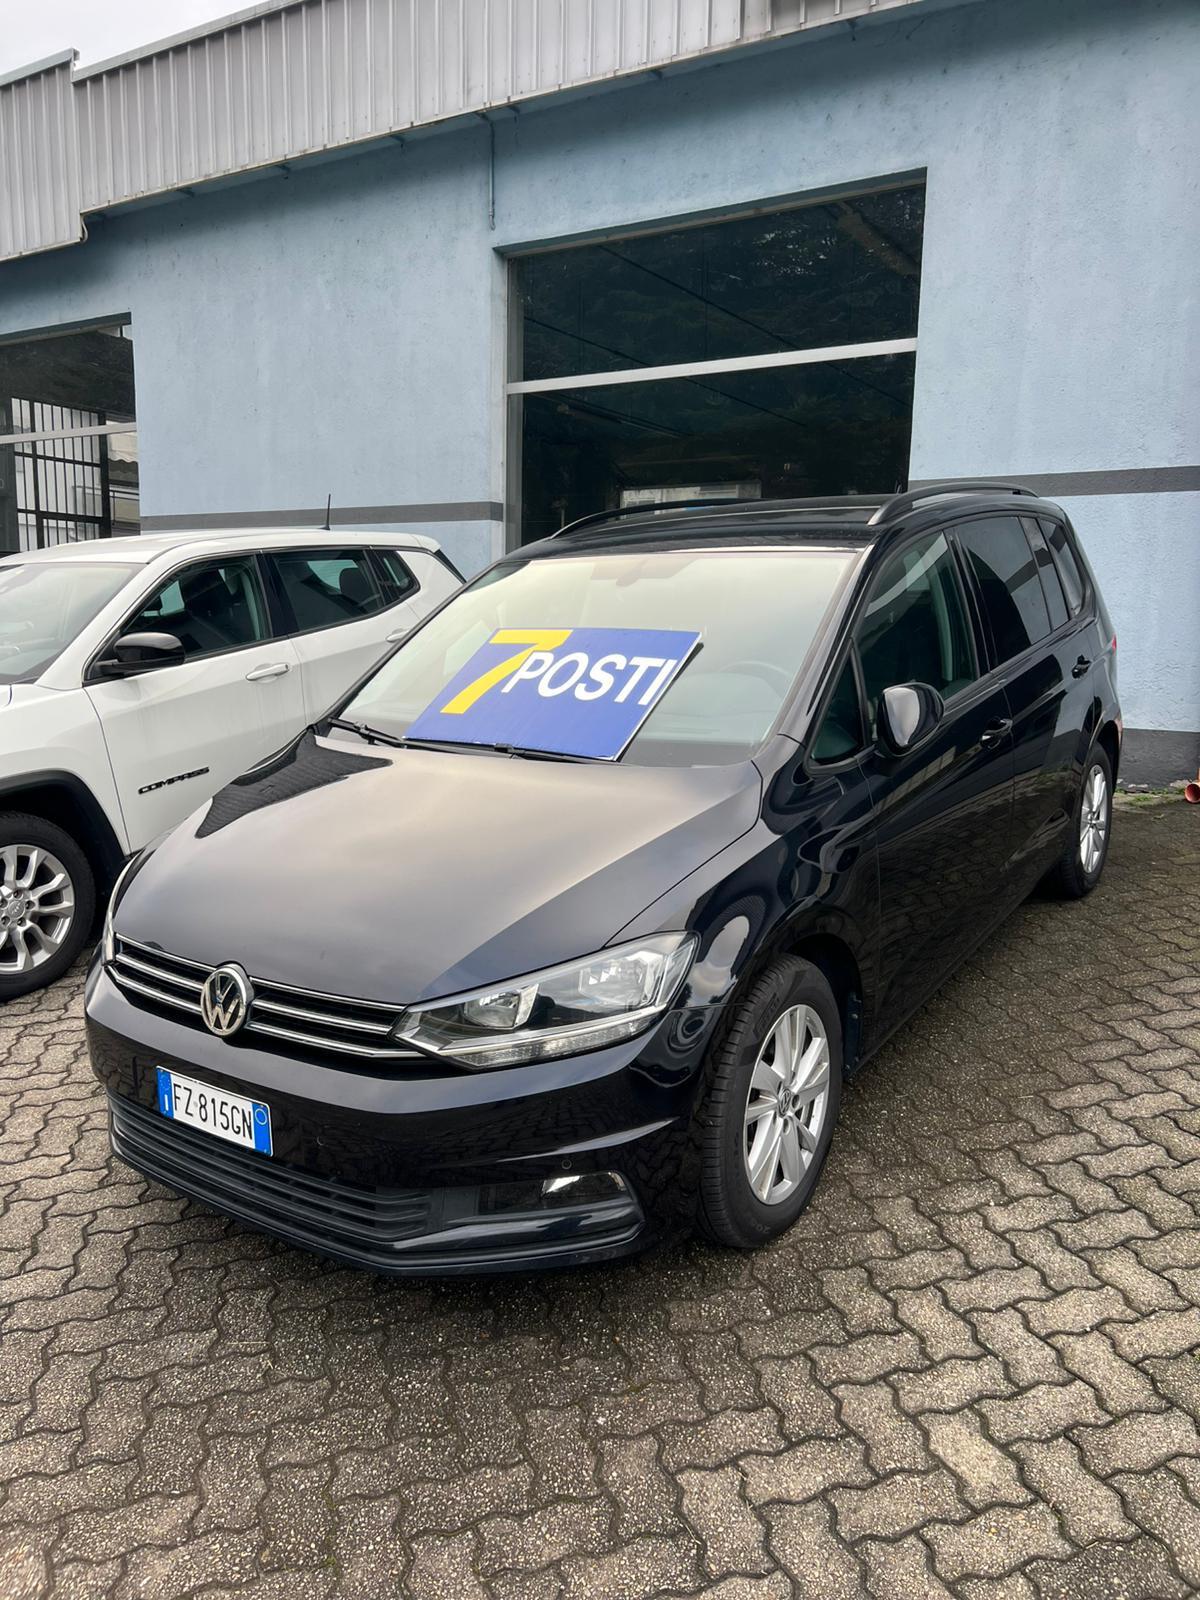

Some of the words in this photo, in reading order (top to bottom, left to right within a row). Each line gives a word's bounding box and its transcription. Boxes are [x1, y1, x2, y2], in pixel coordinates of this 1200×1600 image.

[440, 629, 573, 714] 7
[501, 651, 678, 706] POSTI
[138, 766, 210, 795] COMPASS
